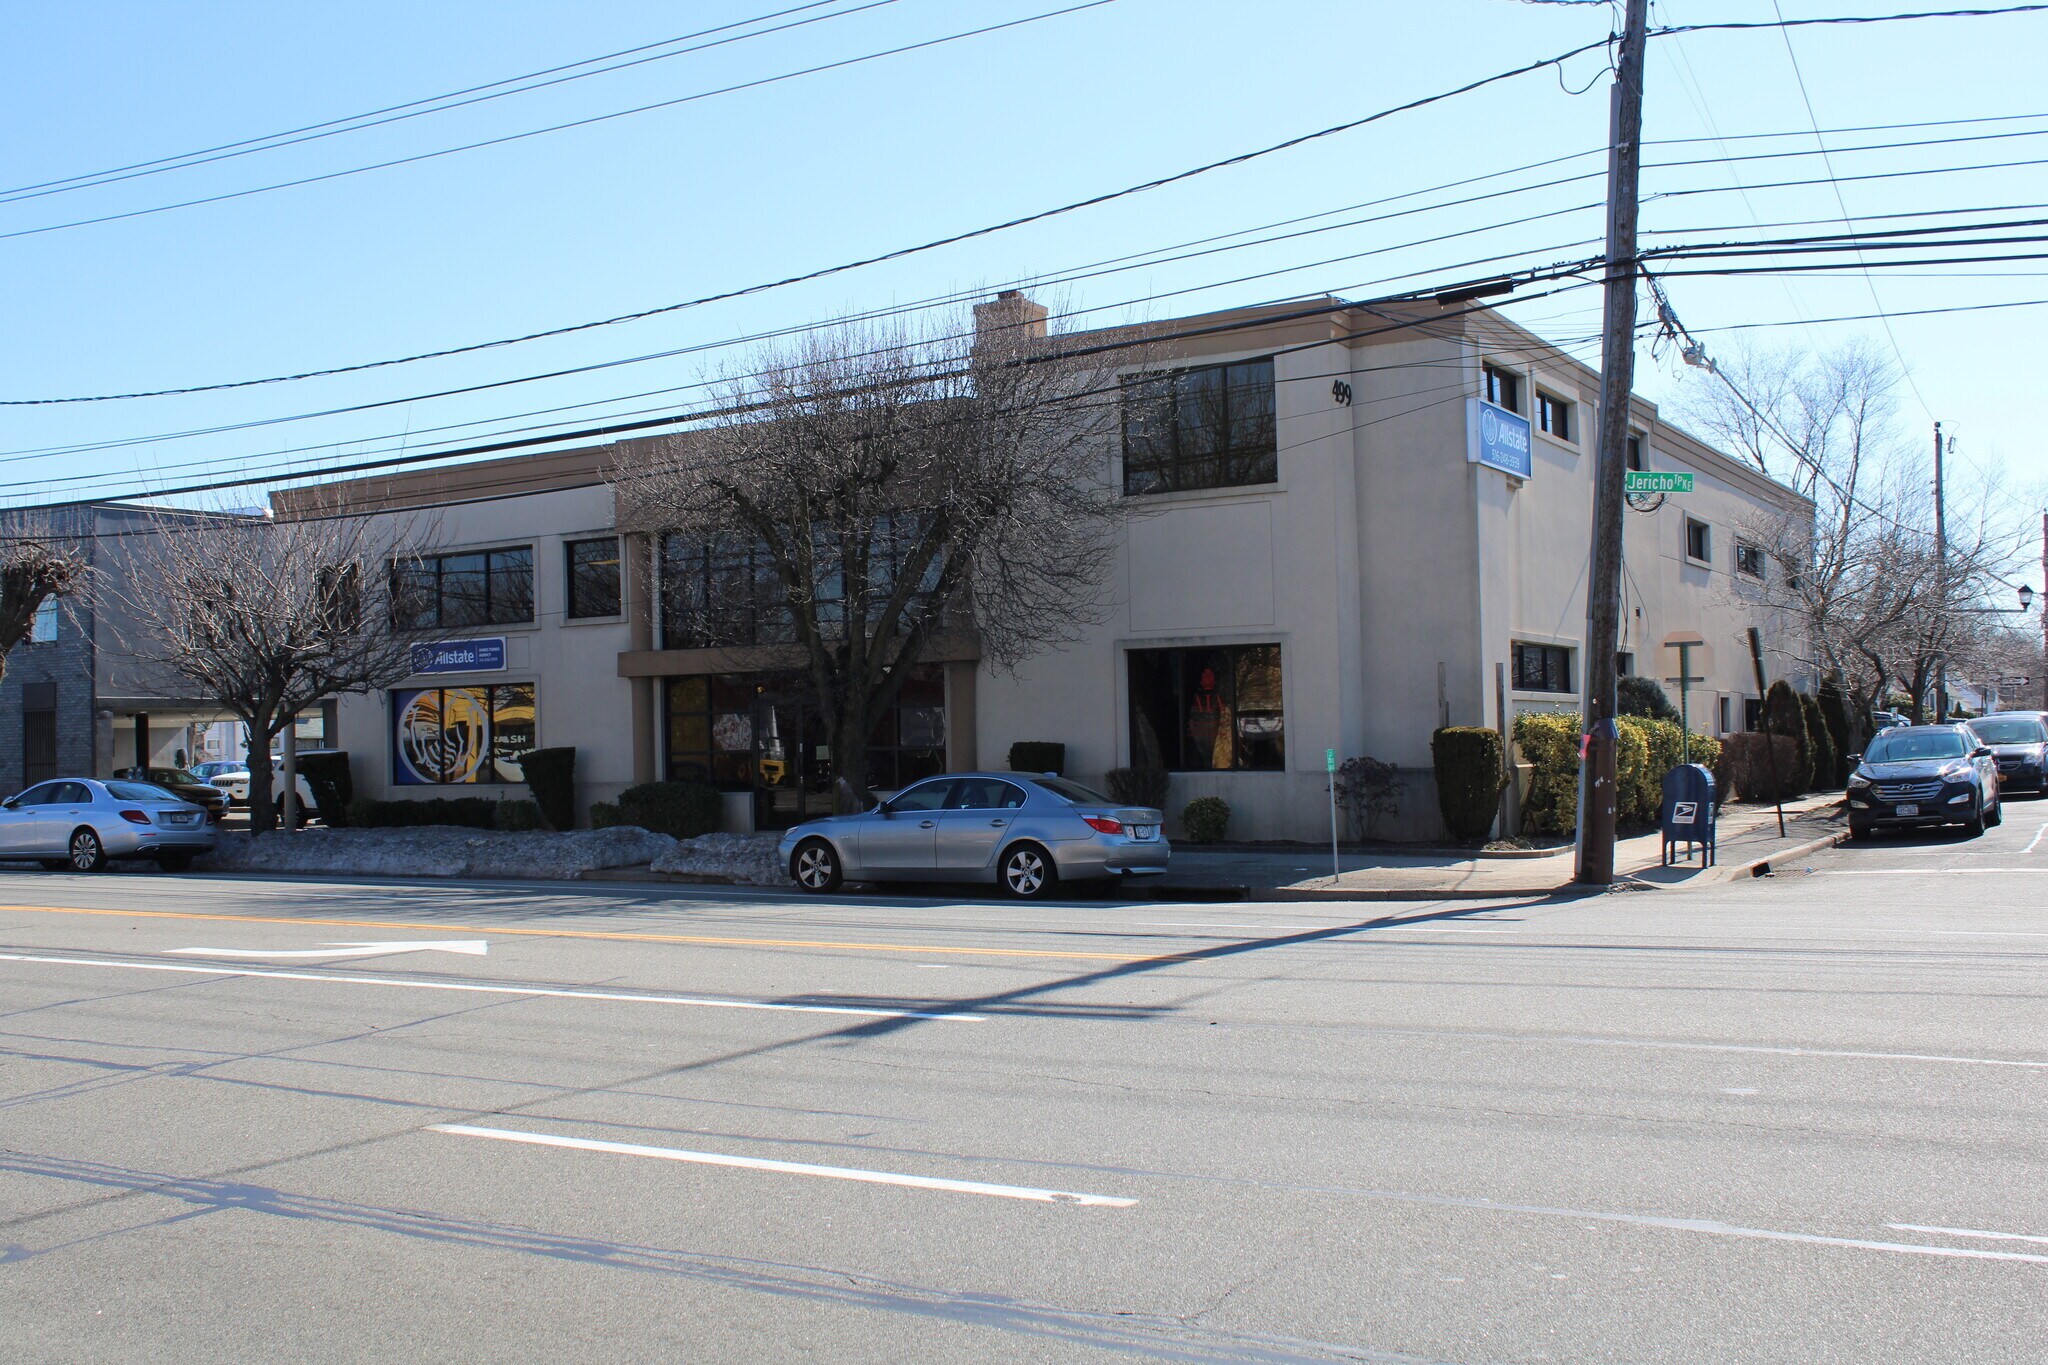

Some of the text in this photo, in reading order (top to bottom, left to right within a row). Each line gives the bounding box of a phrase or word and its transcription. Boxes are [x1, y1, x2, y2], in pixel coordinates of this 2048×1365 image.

[1332, 379, 1352, 407] 499
[1498, 423, 1528, 453] Allstate
[1628, 474, 1674, 490] Jericho
[435, 650, 475, 665] Allstate
